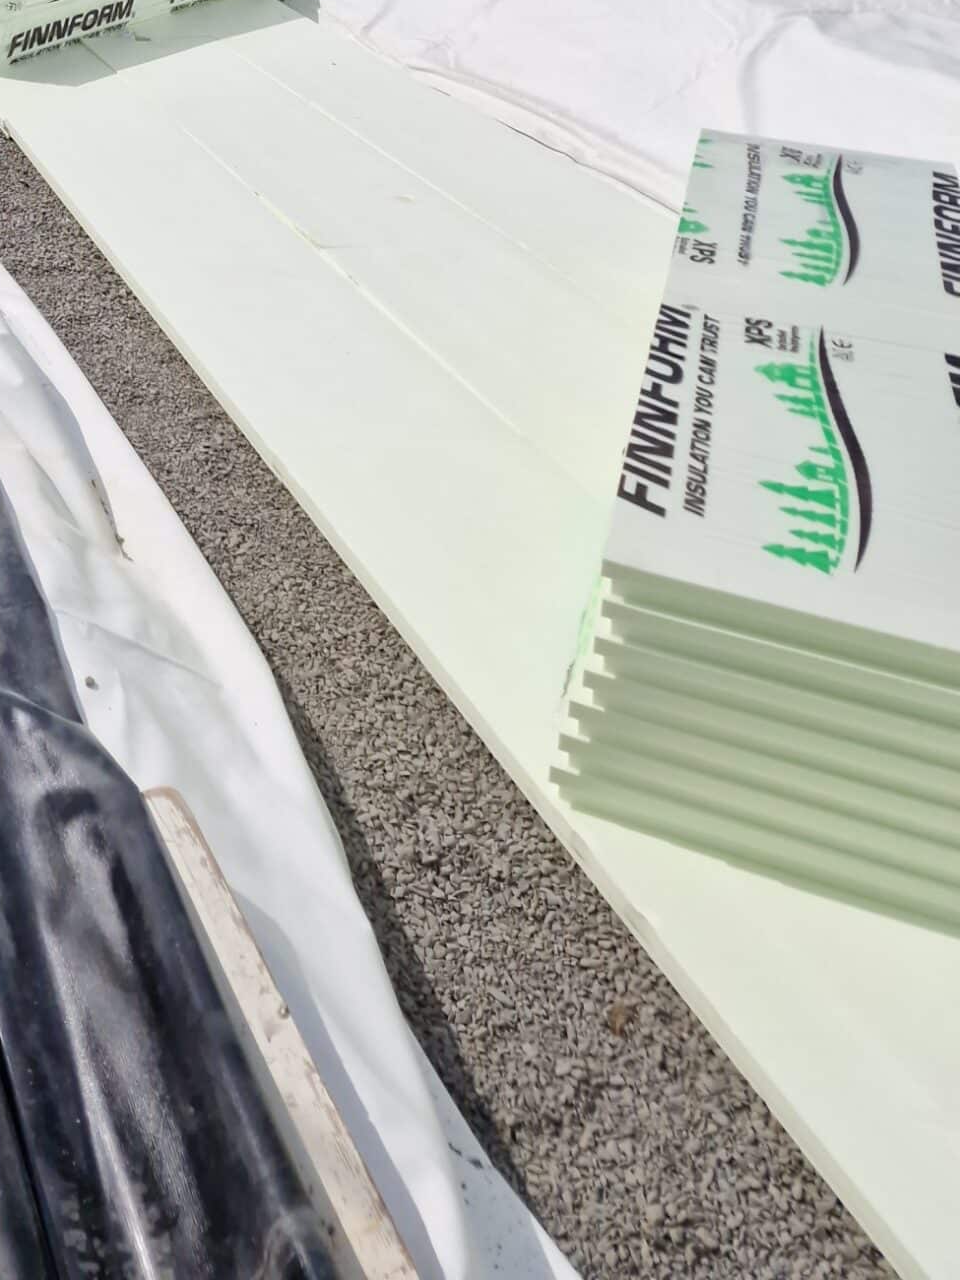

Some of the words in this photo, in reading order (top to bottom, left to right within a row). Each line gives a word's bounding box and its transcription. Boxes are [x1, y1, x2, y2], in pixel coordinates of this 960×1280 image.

[690, 238, 717, 265] XPS
[700, 314, 721, 355] TRUST
[744, 317, 773, 348] XPS
[698, 357, 718, 386] CAN
[694, 386, 715, 416] YOU
[683, 417, 712, 518] INSULATION
